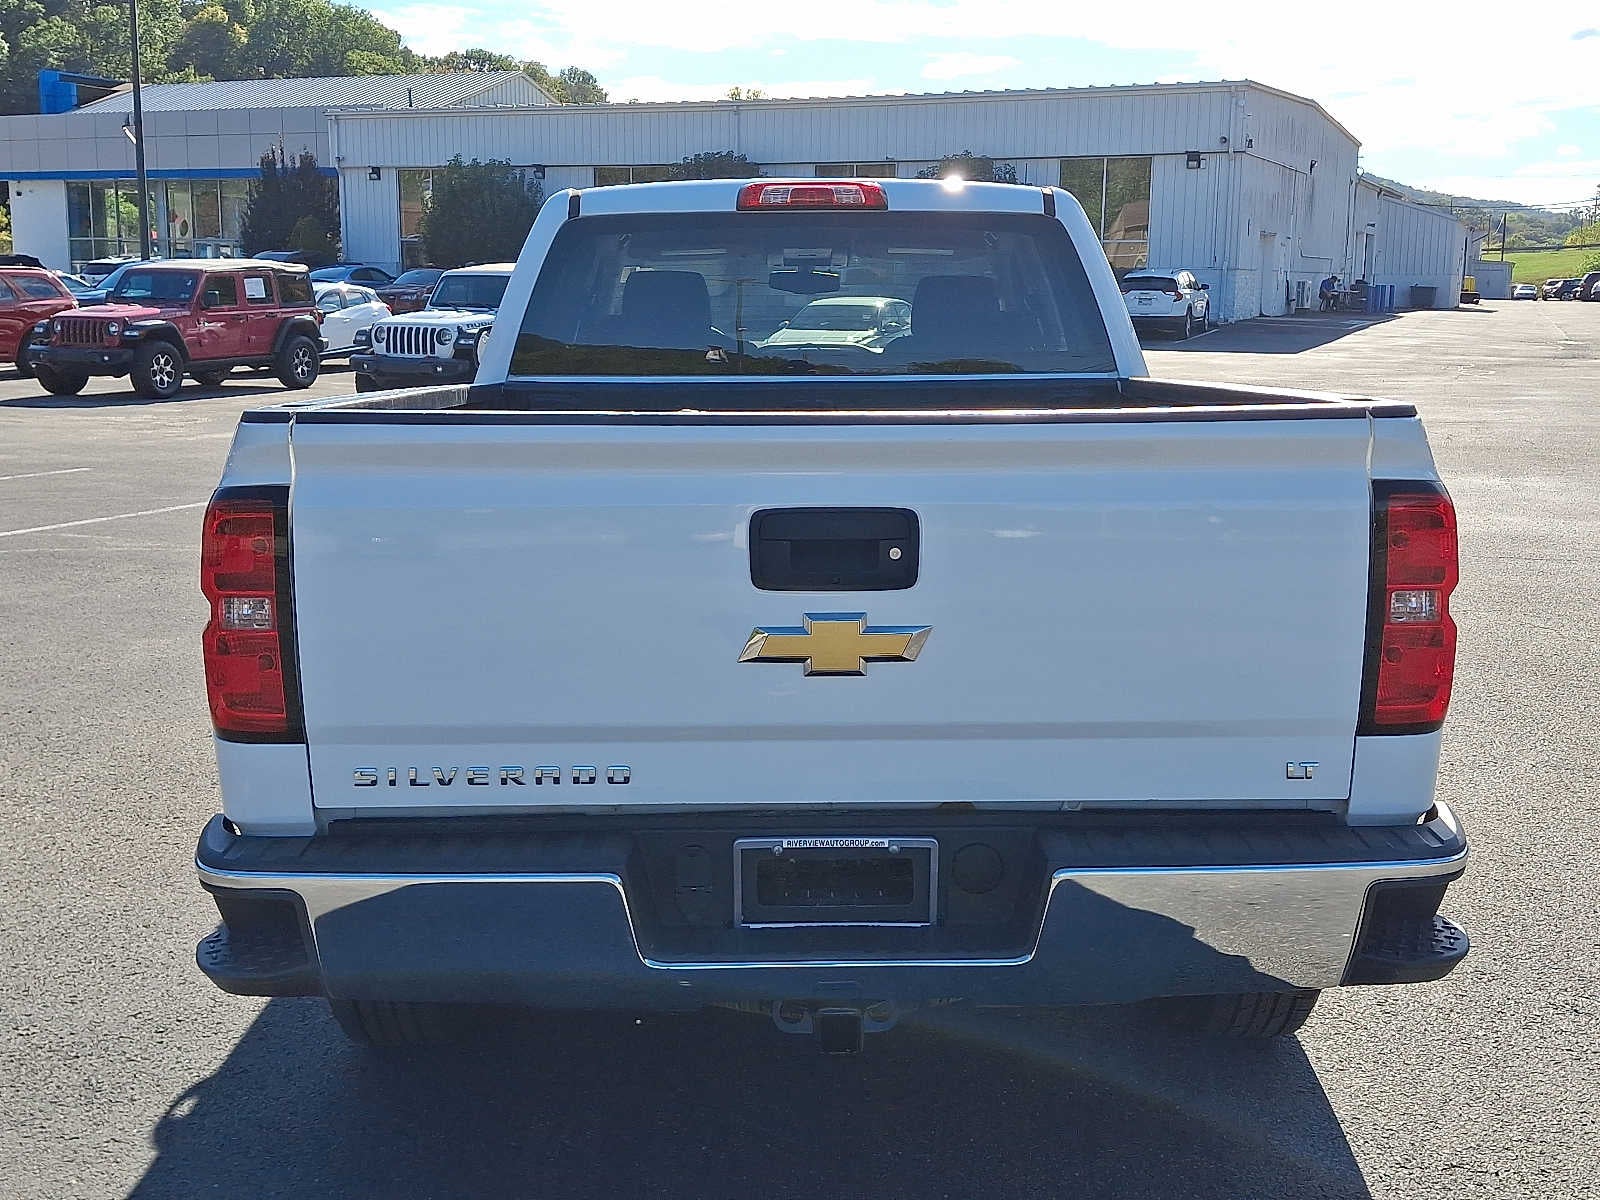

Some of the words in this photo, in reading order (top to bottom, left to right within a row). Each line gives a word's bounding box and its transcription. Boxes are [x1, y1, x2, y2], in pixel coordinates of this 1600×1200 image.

[353, 765, 632, 787] SILVERADO
[1286, 761, 1319, 779] LT
[786, 839, 886, 848] RIVERVIEWAUTOGROUP.com
